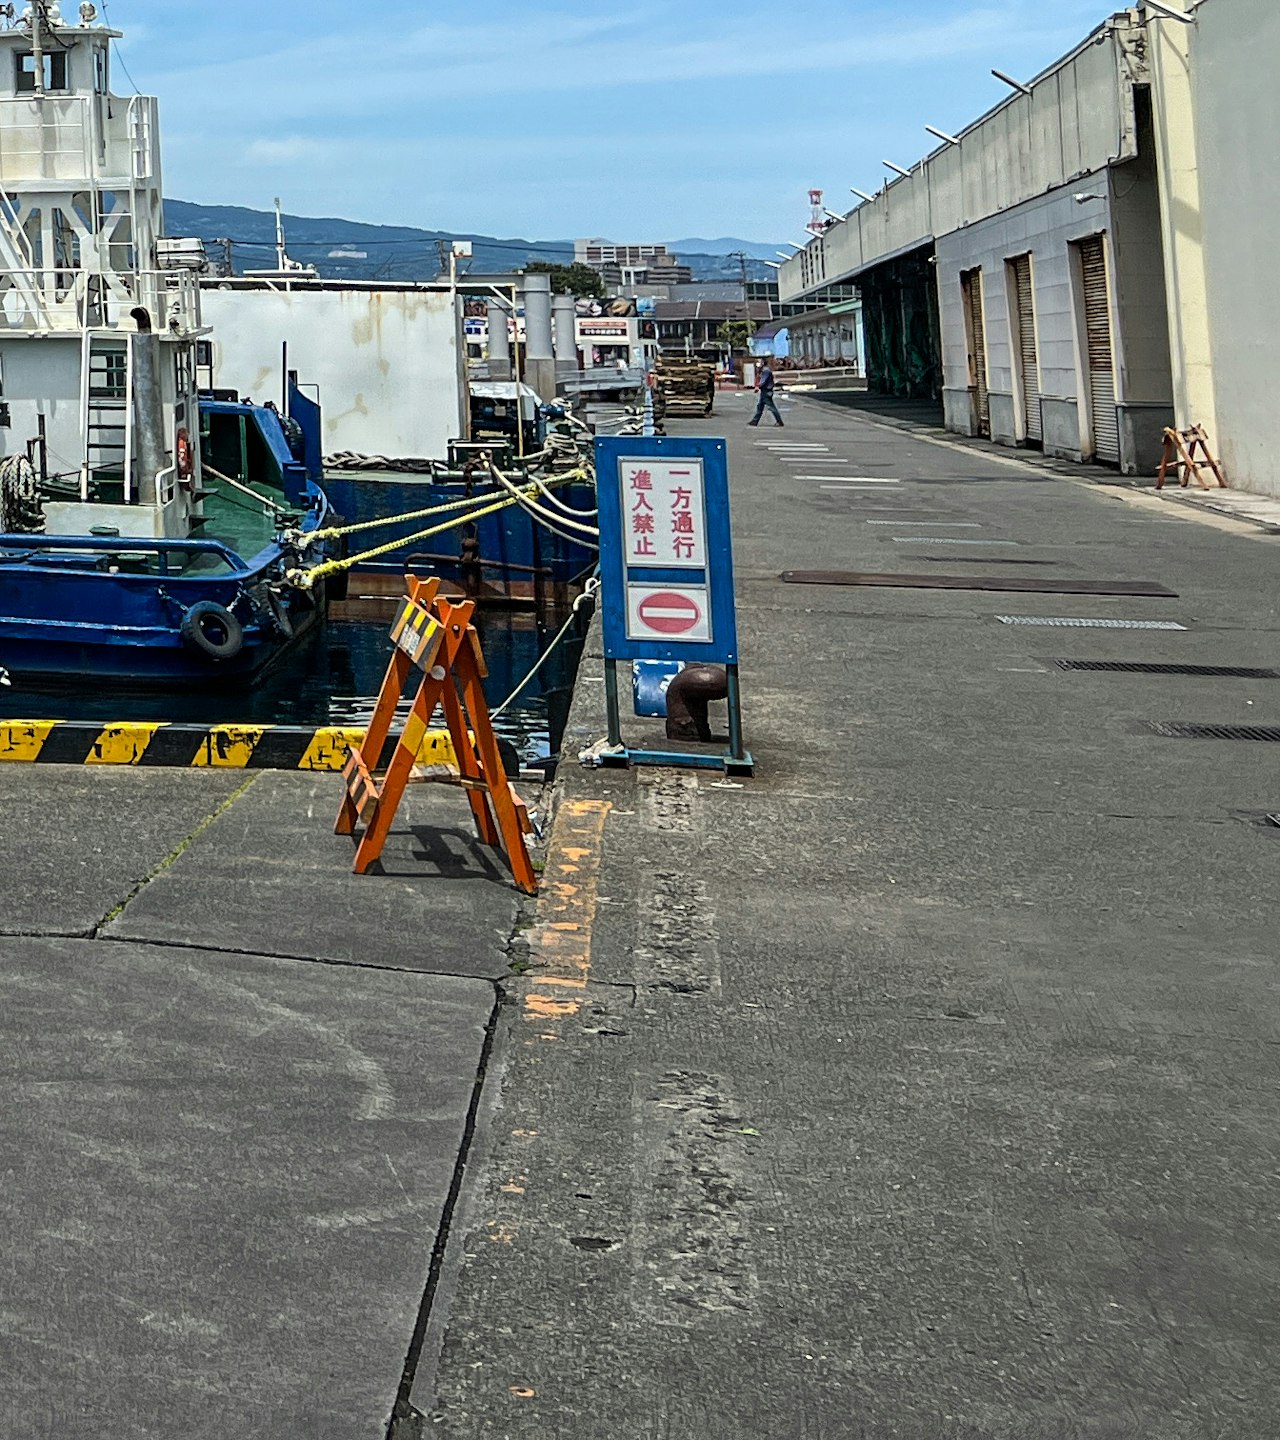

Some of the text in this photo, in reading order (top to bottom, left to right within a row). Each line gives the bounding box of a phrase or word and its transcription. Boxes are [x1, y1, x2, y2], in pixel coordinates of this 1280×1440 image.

[629, 470, 657, 557] 進入禁止
[668, 470, 695, 559] 一方通行
